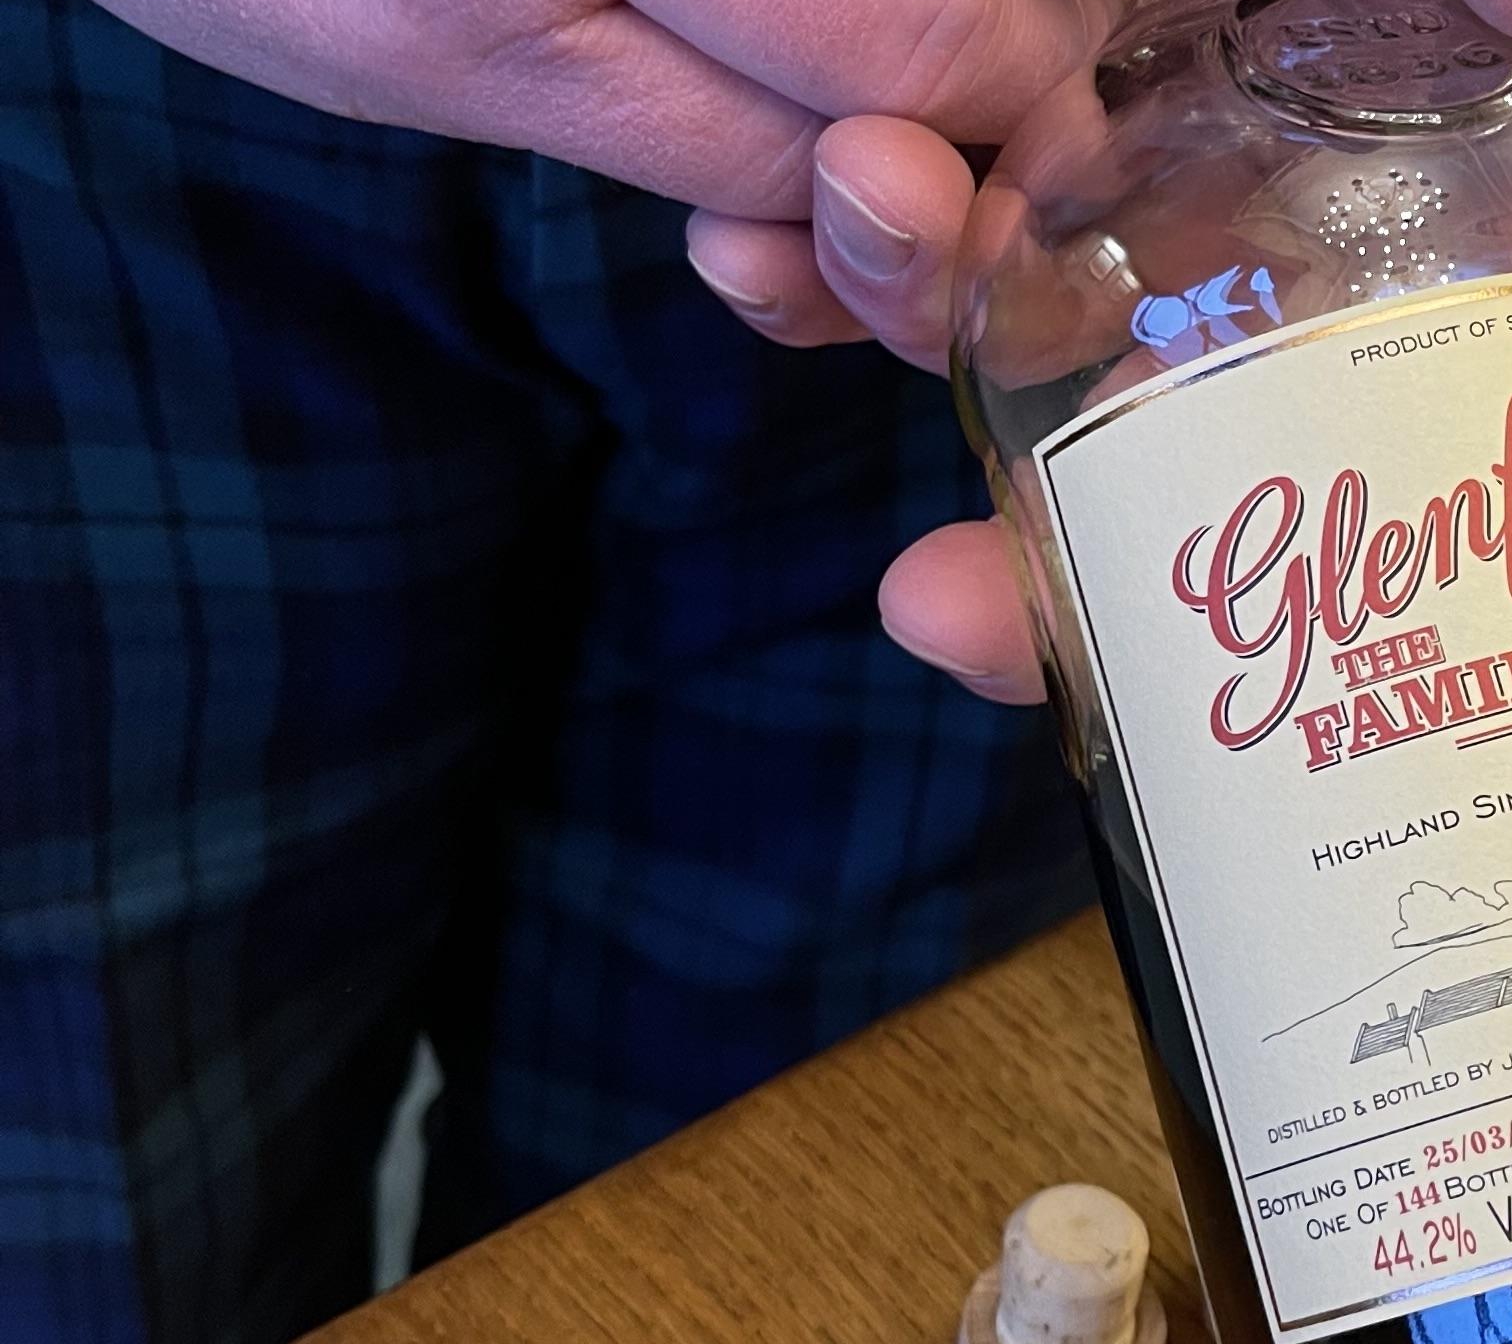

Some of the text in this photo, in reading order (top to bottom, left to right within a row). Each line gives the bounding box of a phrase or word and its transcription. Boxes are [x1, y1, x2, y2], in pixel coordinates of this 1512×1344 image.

[1350, 324, 1461, 367] PRODUCT
[1468, 317, 1498, 338] OF
[1332, 623, 1446, 691] THE
[1311, 809, 1460, 871] HIGHLAND
[1267, 1106, 1347, 1144] DISTILLED
[1353, 1100, 1368, 1117] &
[1372, 1071, 1460, 1111] BOTTLED
[1466, 1059, 1493, 1081] BY
[1257, 1179, 1347, 1220] BOTTLING
[1354, 1158, 1416, 1190] DATE
[1306, 1214, 1352, 1240] ONE
[1357, 1201, 1389, 1225] OF
[1394, 1180, 1443, 1215] 144
[1373, 1212, 1478, 1277] 44.2%
